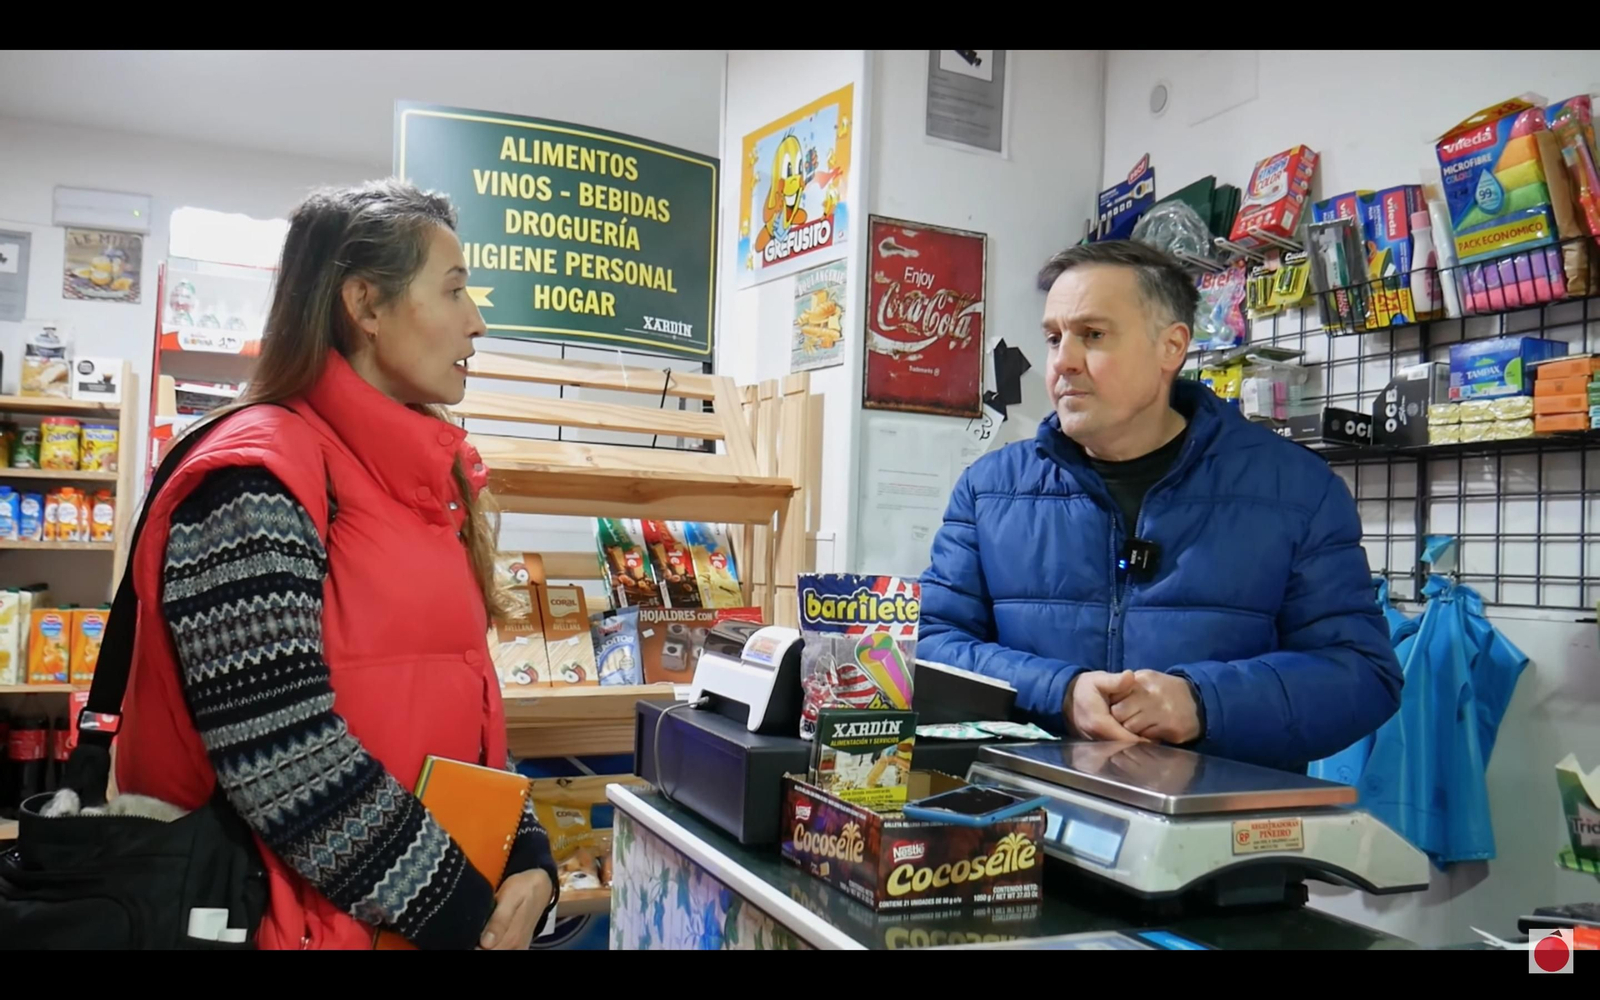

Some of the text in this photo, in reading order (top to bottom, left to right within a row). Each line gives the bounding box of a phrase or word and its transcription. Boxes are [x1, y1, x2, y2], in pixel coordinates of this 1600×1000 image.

[1442, 126, 1493, 154] vileda
[500, 136, 639, 181] ALIMENTOS
[1443, 152, 1493, 176] MICROFIBRE
[473, 169, 552, 201] VINOS
[579, 182, 671, 223] BEBIDAS
[505, 208, 640, 251] DROGUERÍA
[1386, 196, 1398, 237] vileda
[764, 219, 831, 263] GREFUSITO
[1458, 221, 1544, 252] PACK ECONOMICO
[565, 251, 677, 294] PERSONAL
[904, 266, 935, 289] Enjoy
[534, 284, 616, 317] HOGAR
[642, 315, 693, 338] XARDÍN
[1466, 365, 1501, 380] TAMPAX
[1385, 388, 1398, 433] OCB
[550, 598, 577, 607] CORAL
[806, 592, 919, 622] barrilete
[552, 623, 581, 631] AVELLANA
[640, 610, 696, 624] HOJALDRES
[697, 613, 713, 621] CON
[832, 718, 903, 738] XARDÍN
[830, 738, 868, 747] ALIMENTACIÓN
[873, 737, 899, 745] SERVICIOS
[1251, 821, 1299, 830] REGISTRADORAS
[1259, 829, 1291, 838] PIÑEIRO
[793, 821, 865, 863] Cocosette
[886, 832, 1037, 896] Cocosette
[993, 884, 1023, 894] CONTENIDO
[878, 899, 903, 908] CONTIENE
[903, 899, 910, 907] 21
[910, 898, 935, 906] UNIDADES
